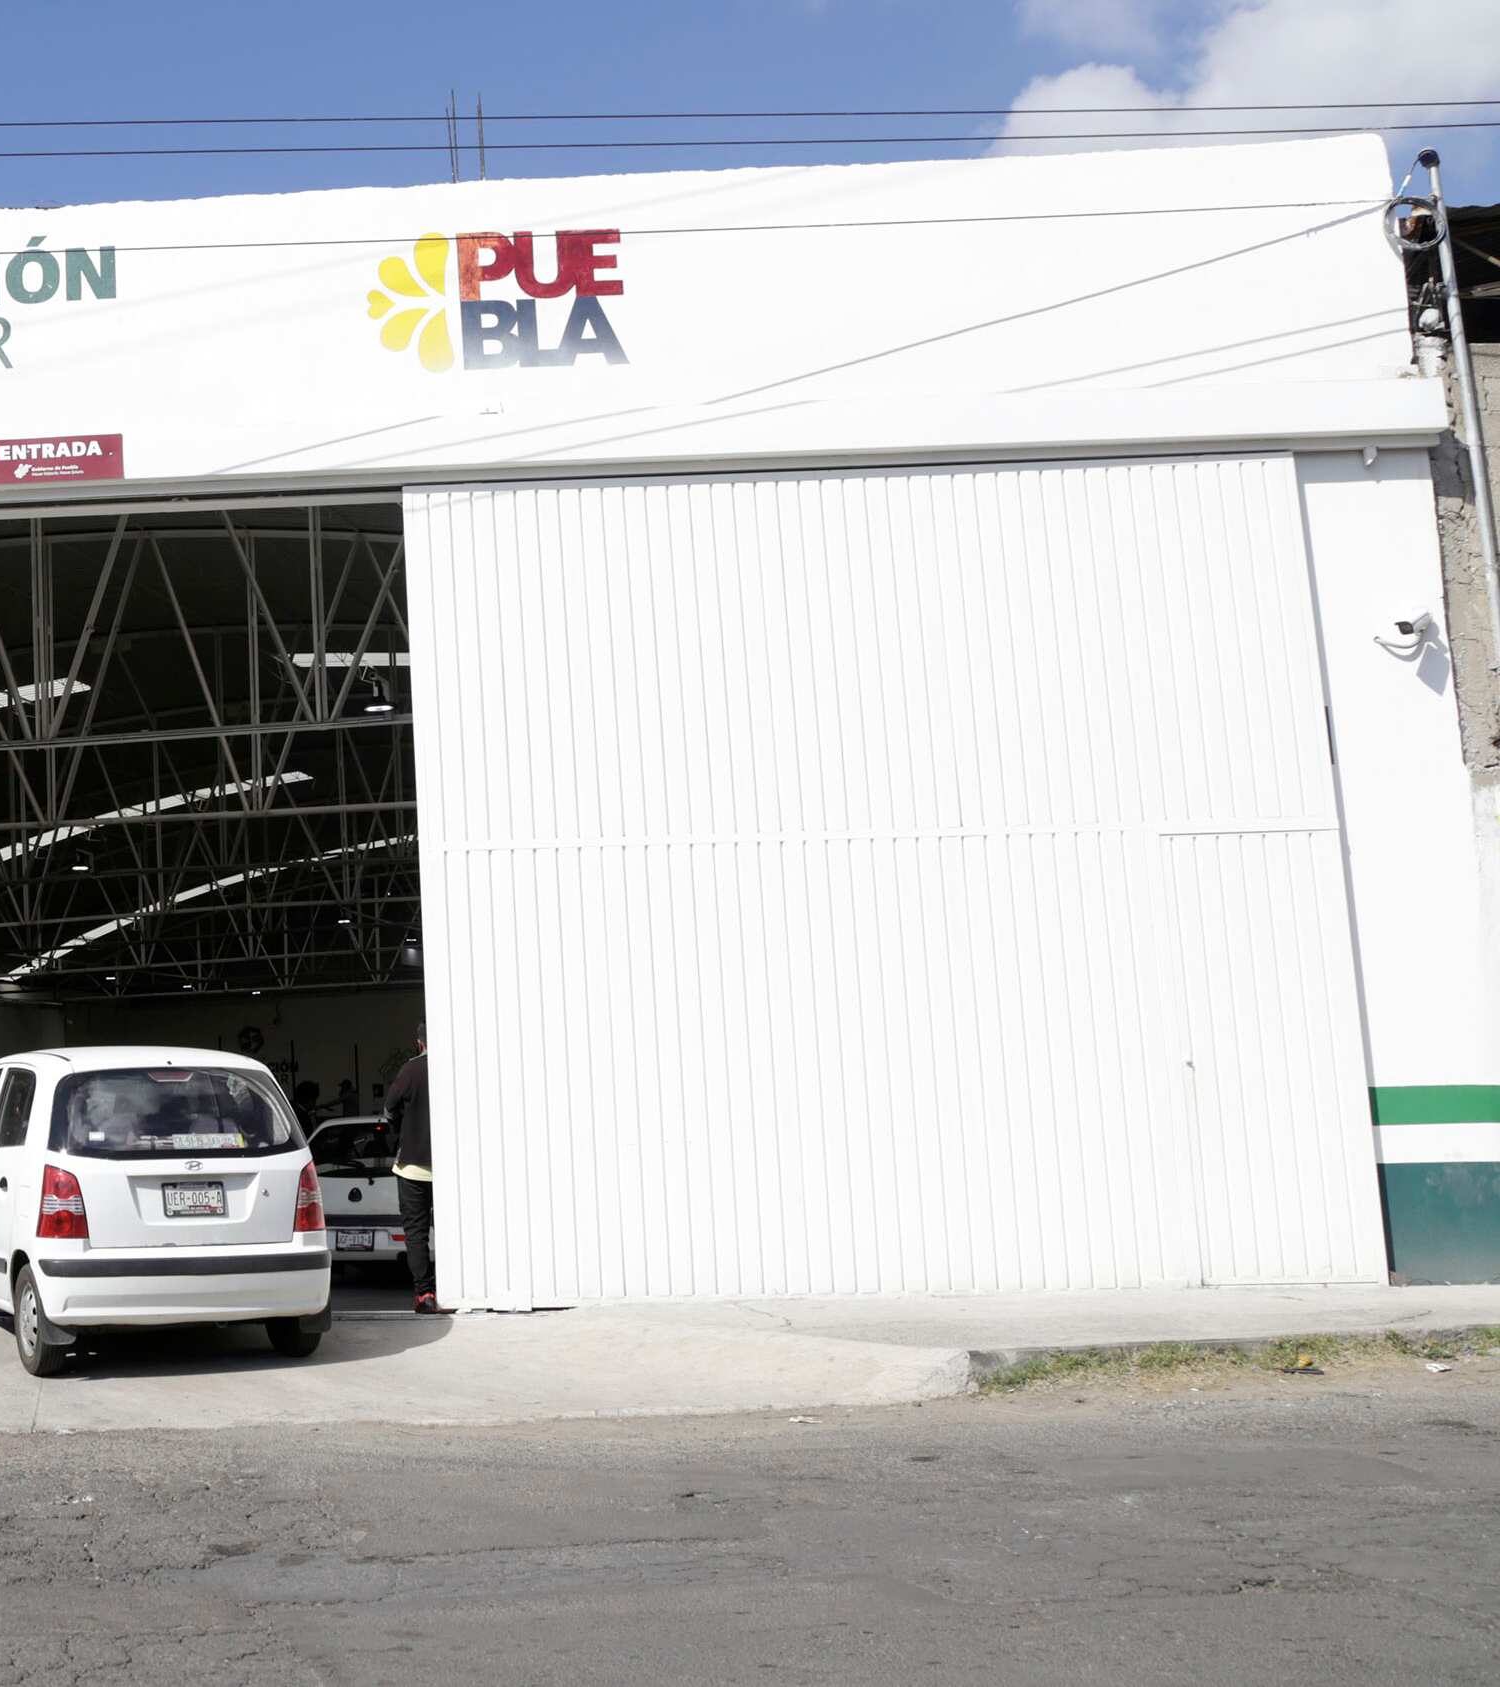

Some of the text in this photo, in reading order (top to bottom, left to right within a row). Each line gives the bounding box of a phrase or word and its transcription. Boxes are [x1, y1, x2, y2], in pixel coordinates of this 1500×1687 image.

[456, 229, 624, 302] PUE
[460, 295, 630, 370] BLA
[166, 1191, 222, 1206] UER-005-A
